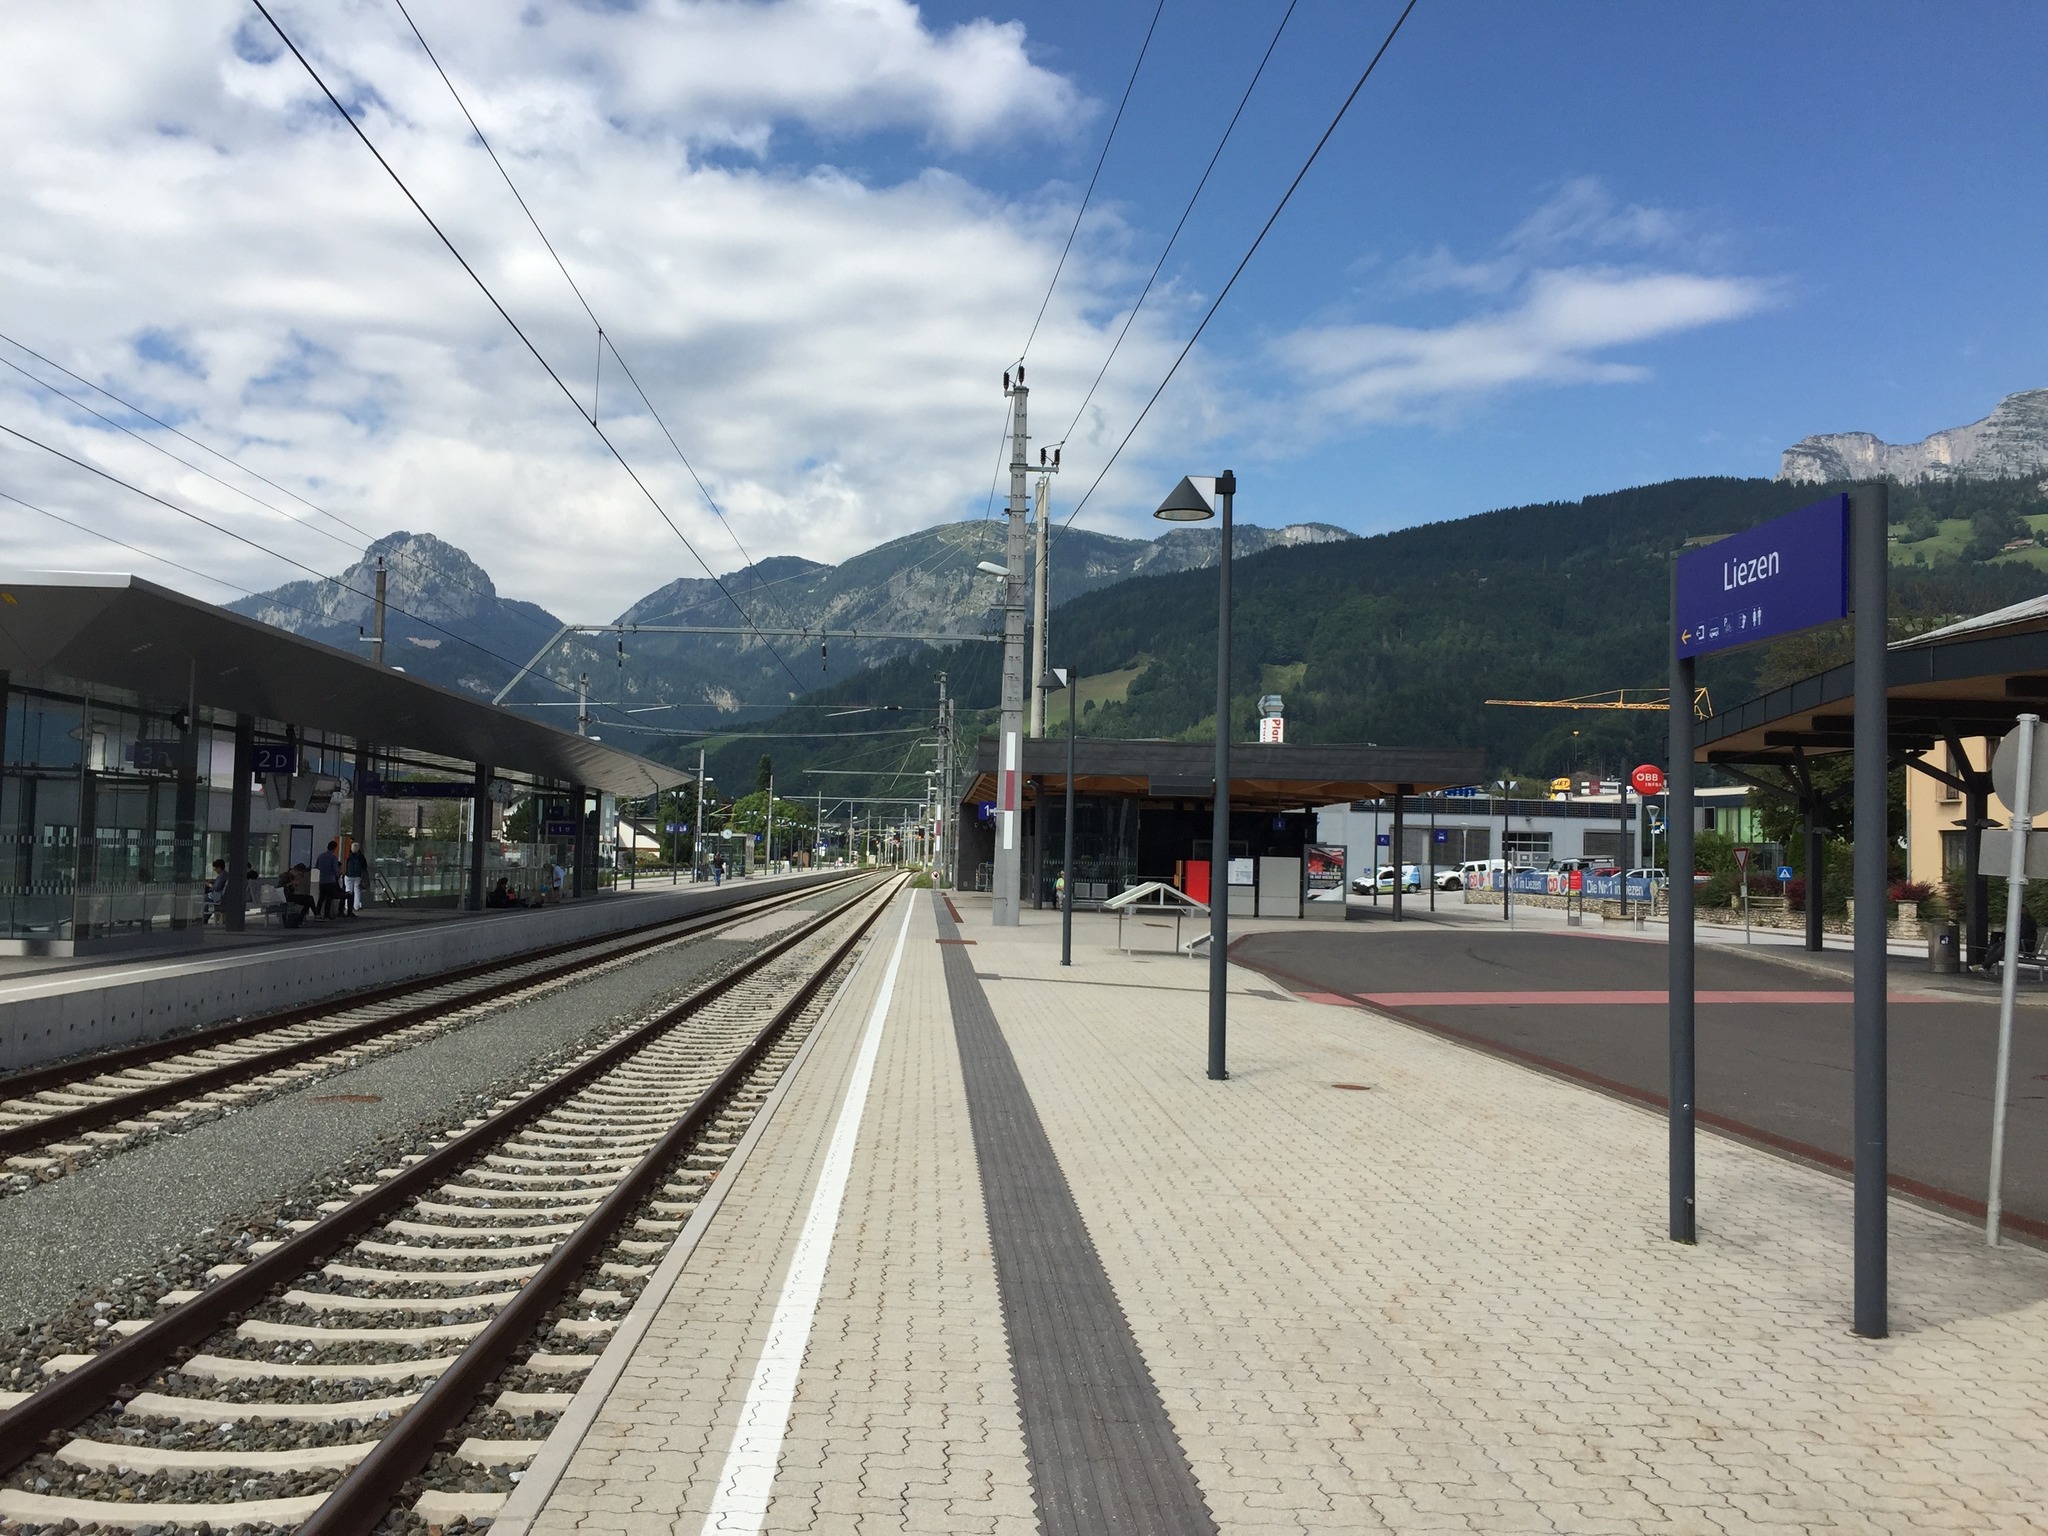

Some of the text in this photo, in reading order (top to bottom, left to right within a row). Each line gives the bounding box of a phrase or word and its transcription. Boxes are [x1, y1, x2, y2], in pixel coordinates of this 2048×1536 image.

[1723, 551, 1780, 591] Liezen
[258, 750, 287, 769] 2 D
[1636, 773, 1659, 782] ÖBB
[984, 804, 989, 816] 1
[1525, 877, 1542, 890] Liezen
[1586, 880, 1597, 894] Die
[1614, 881, 1621, 895] in
[1625, 881, 1644, 896] iezen
